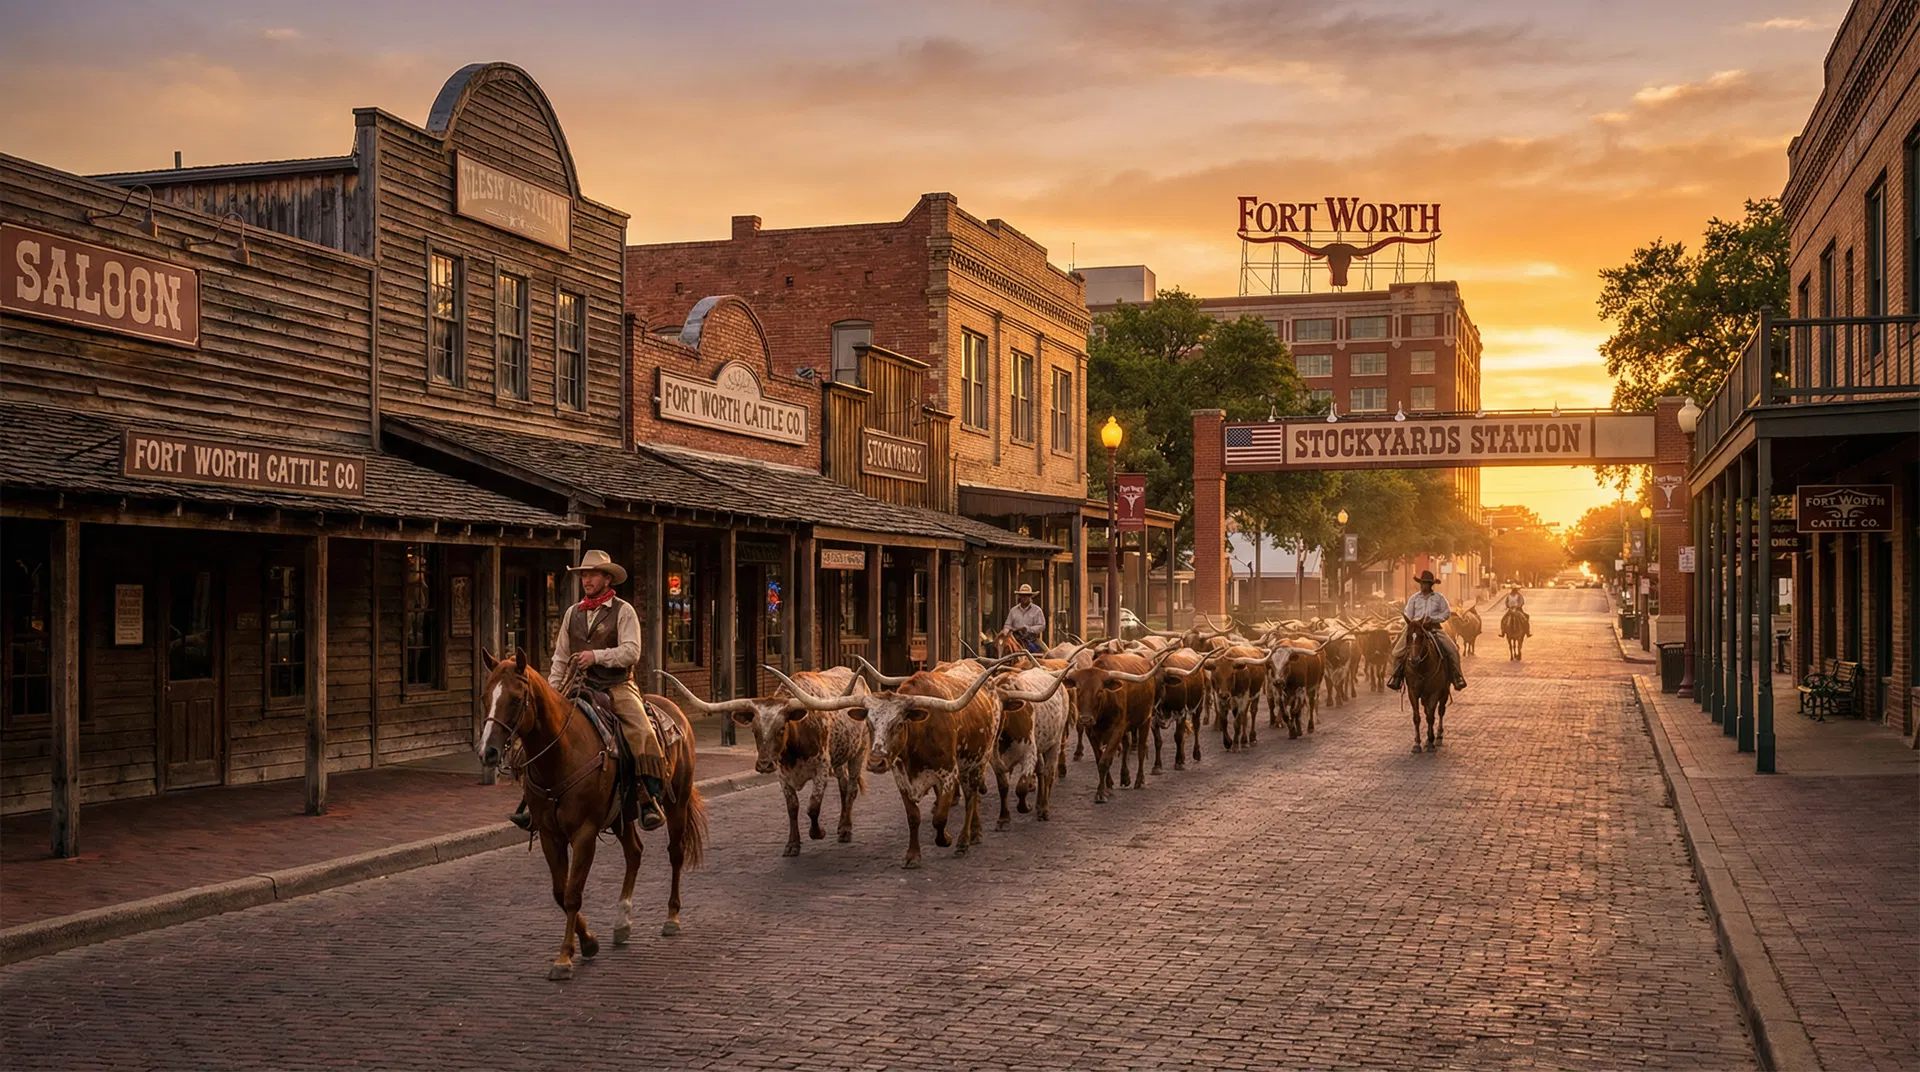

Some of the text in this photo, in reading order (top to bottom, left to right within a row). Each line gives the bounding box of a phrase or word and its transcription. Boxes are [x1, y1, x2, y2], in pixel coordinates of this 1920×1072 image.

[1237, 196, 1441, 232] FORT WORTH
[16, 240, 182, 331] SALOON
[664, 381, 803, 436] FORT WORTH CATTLE CO.
[1294, 423, 1582, 458] STOCKYARDS STATION
[134, 438, 358, 490] FORT WORTH CATTLE CO.
[1805, 495, 1885, 507] FORT WORTH
[1810, 518, 1880, 528] CATTLE CO.
